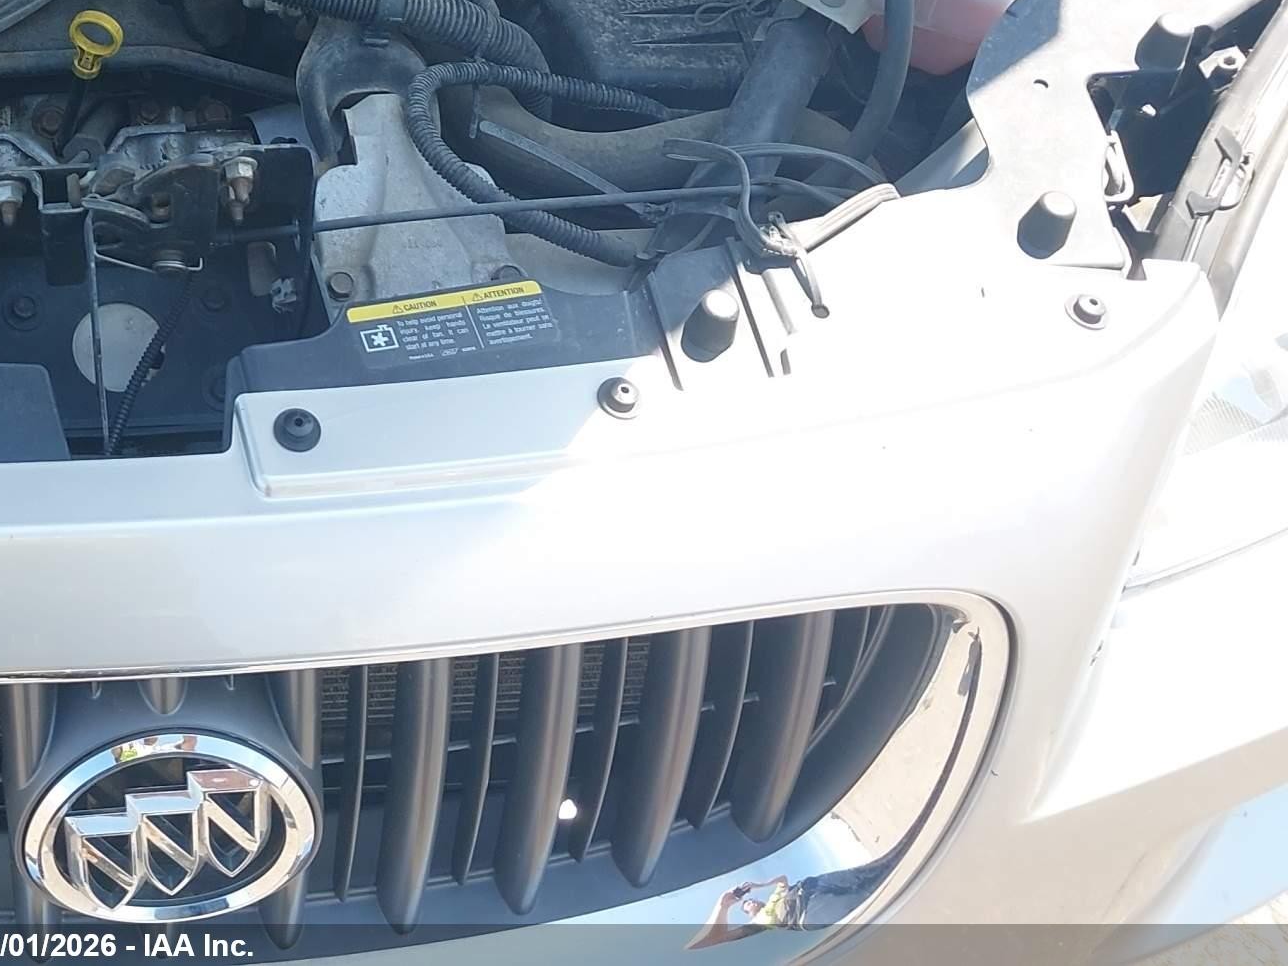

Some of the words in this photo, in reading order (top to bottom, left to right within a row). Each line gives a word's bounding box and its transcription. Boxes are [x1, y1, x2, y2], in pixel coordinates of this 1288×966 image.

[483, 287, 525, 299] ATTENTION
[403, 300, 438, 311] CAUTION
[476, 305, 504, 314] Attention
[437, 312, 463, 321] personal
